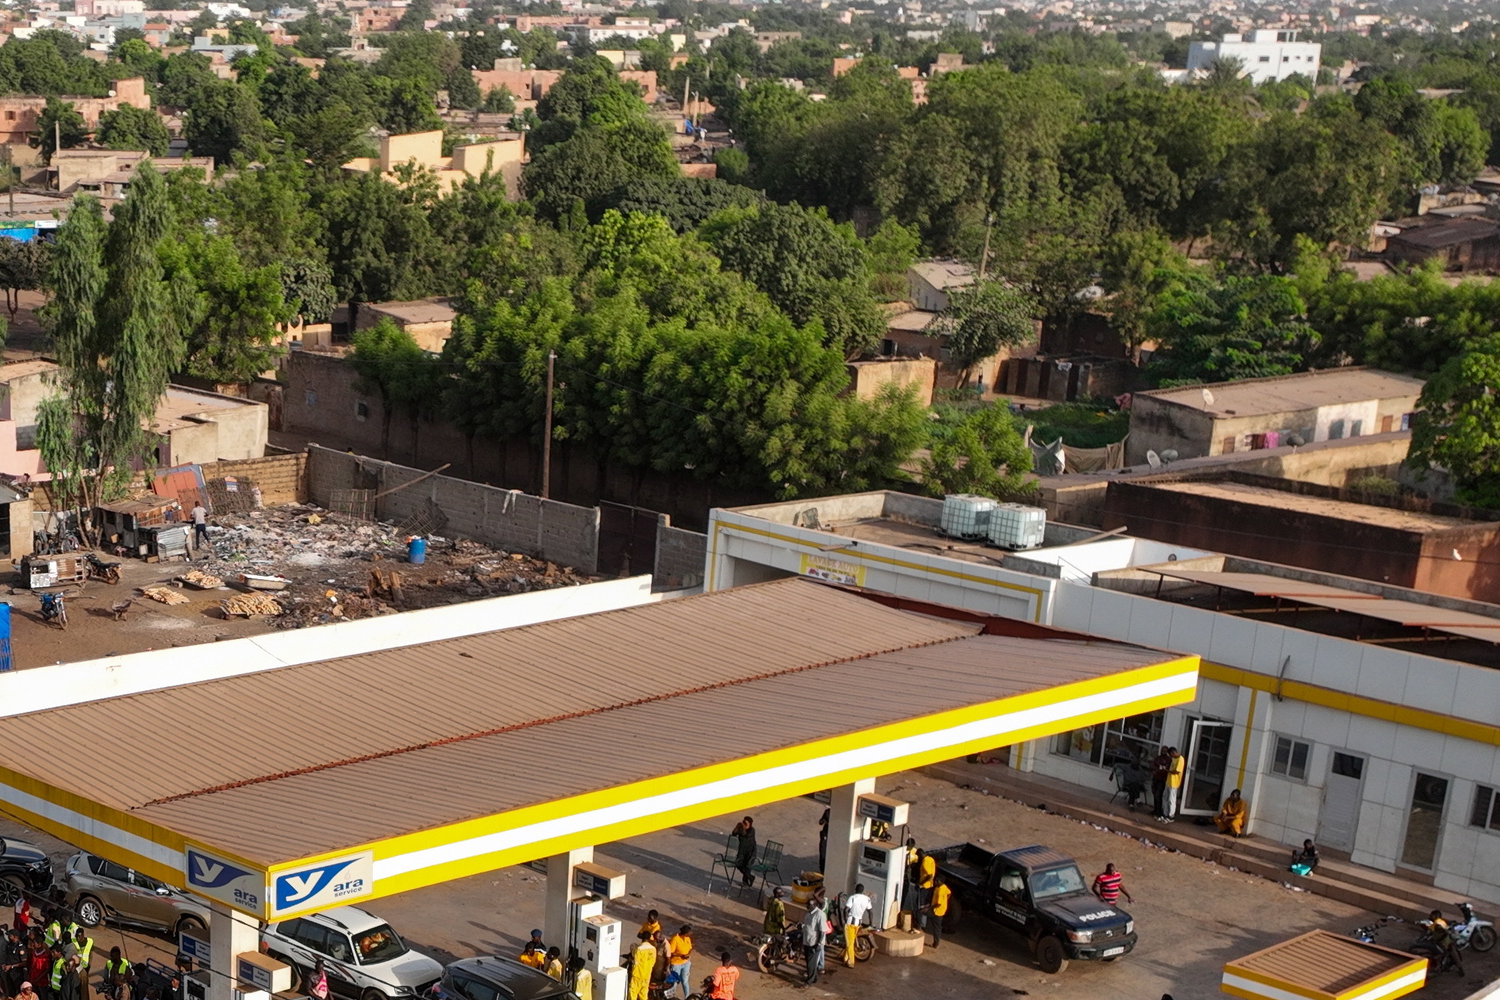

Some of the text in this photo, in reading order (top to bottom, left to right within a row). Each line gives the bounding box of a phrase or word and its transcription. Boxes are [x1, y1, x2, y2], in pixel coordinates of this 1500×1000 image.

[334, 886, 363, 898] service
[235, 897, 258, 910] service
[1079, 909, 1116, 922] POLICE
